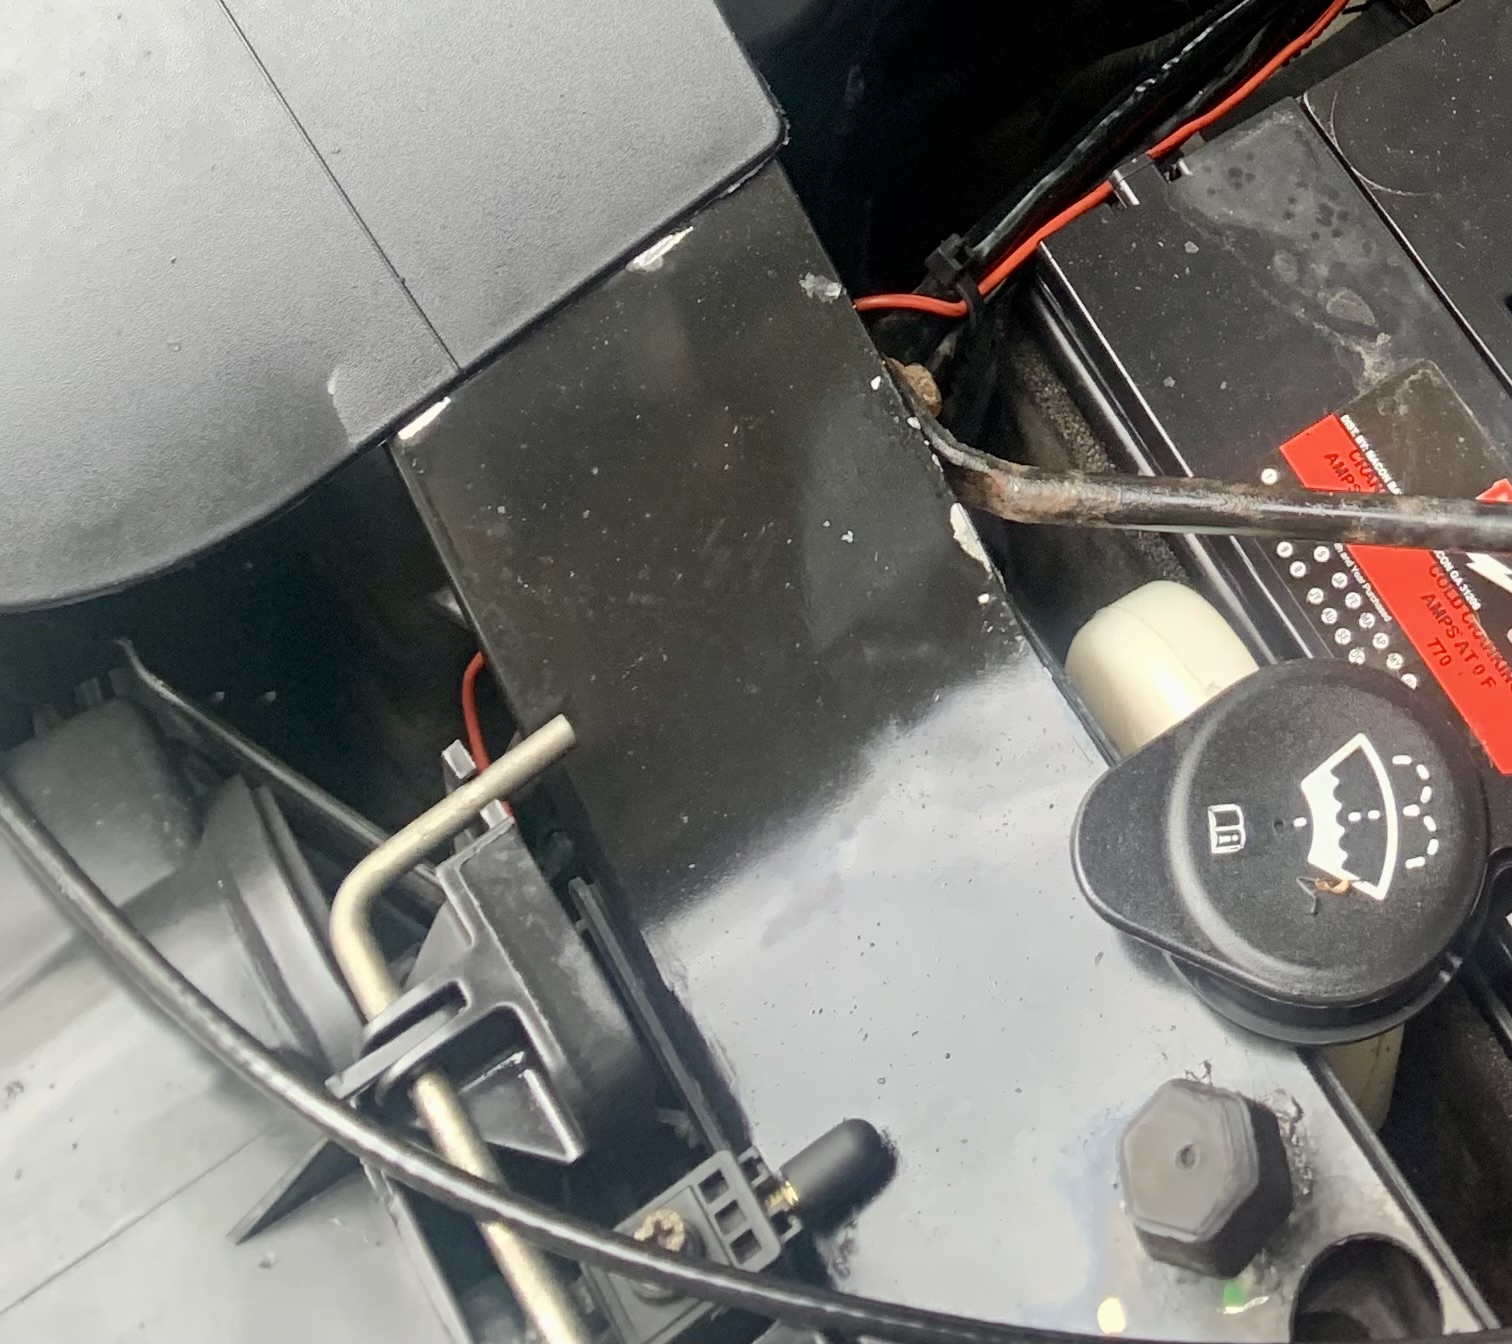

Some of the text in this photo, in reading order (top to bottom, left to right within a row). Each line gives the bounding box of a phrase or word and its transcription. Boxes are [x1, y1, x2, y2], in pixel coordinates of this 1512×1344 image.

[1339, 413, 1360, 438] DIST.
[1354, 434, 1370, 452] BY:
[1364, 448, 1392, 483] MACON
[1448, 569, 1463, 586] GA
[1339, 550, 1354, 568] and
[1349, 565, 1366, 585] Year
[1360, 582, 1392, 623] Purchased
[1425, 560, 1466, 612] COLD
[1420, 589, 1462, 641] AMPS
[1453, 636, 1479, 666] AT
[1480, 674, 1497, 691] F
[1425, 636, 1453, 668] 770
